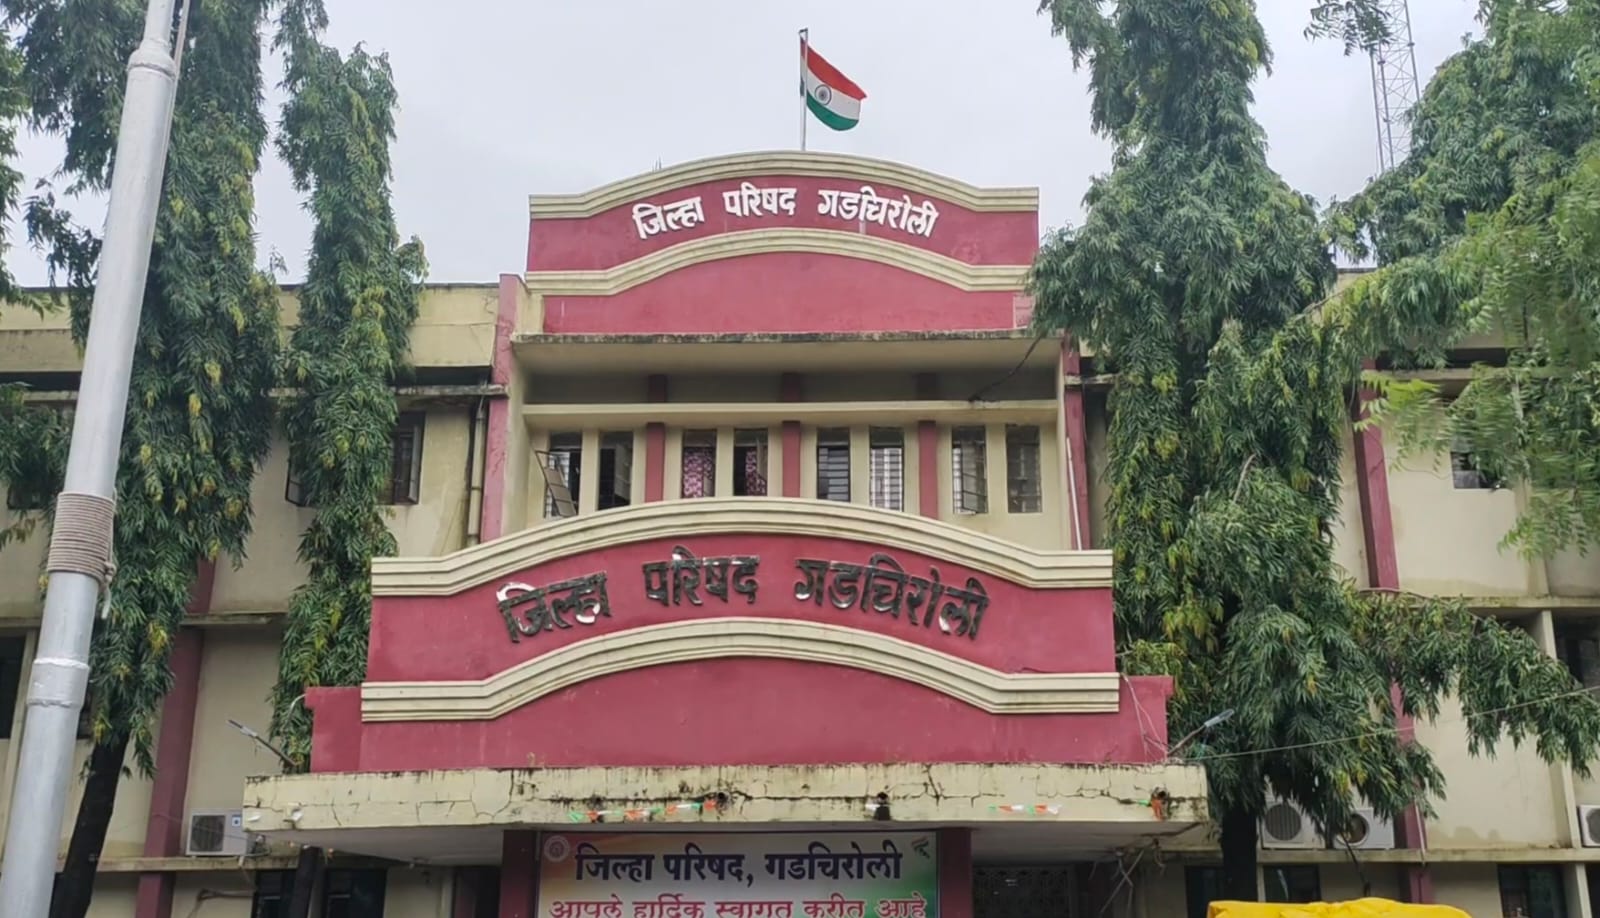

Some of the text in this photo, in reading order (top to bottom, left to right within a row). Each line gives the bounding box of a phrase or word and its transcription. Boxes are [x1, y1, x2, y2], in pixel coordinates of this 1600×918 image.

[632, 181, 940, 240] जिल्हा परिषद गडचिरोली
[495, 545, 991, 643] जिल्हा परिषद गडचिरोली
[575, 839, 903, 888] जिल्हा परिषद, गडचिरोली
